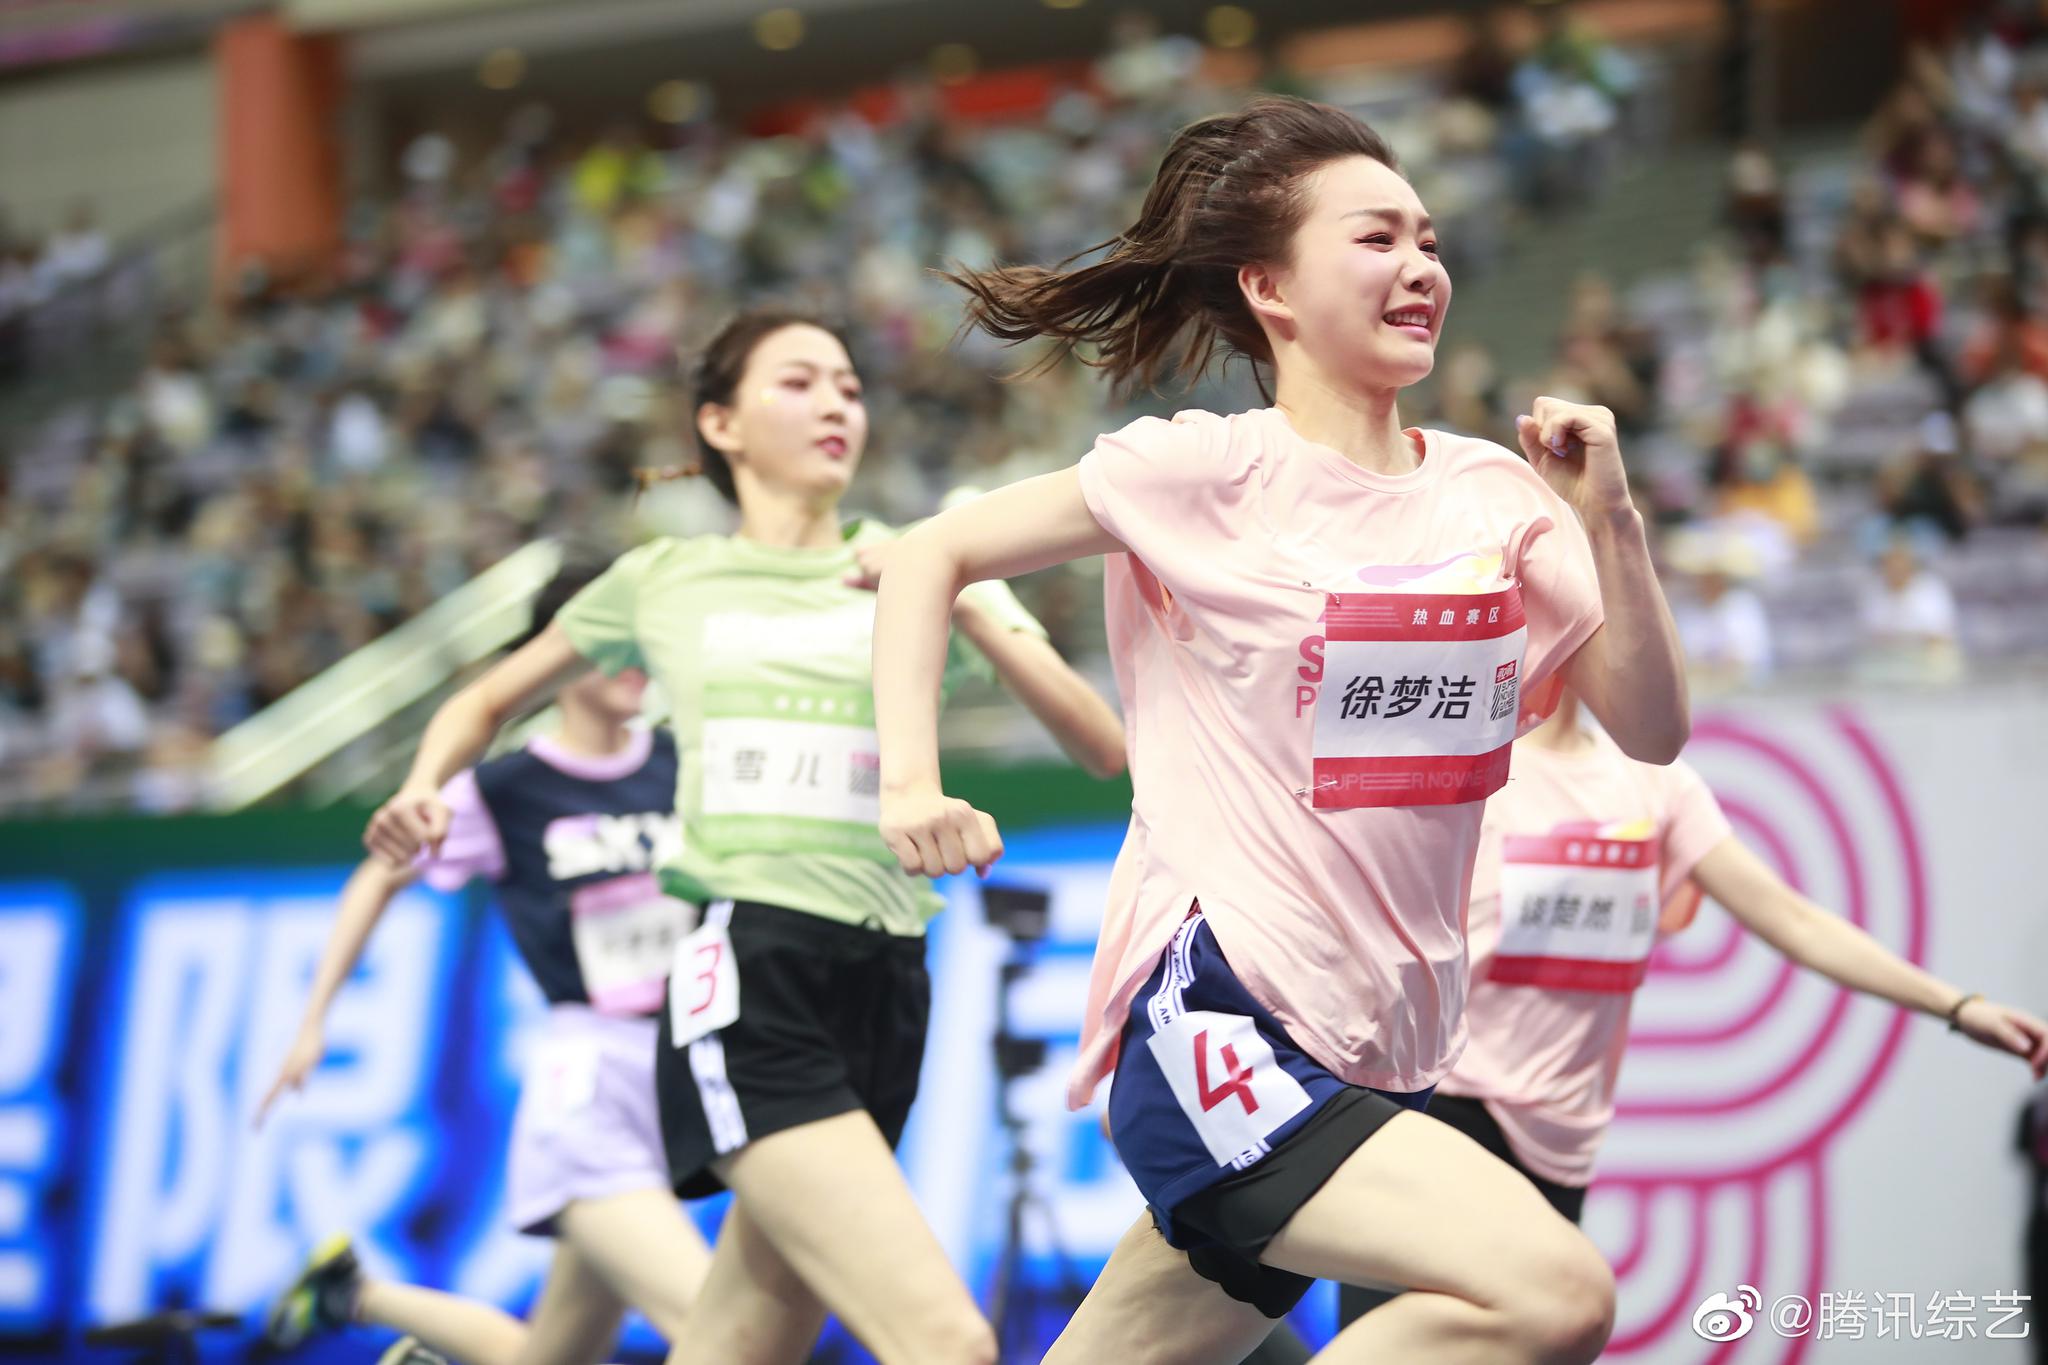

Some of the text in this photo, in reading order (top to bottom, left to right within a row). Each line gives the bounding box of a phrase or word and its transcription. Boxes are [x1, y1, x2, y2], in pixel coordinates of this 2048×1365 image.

[1412, 606, 1500, 625] 热血赛区
[1340, 674, 1477, 720] 徐梦洁
[733, 748, 820, 787] 雪儿
[690, 943, 722, 1016] 3
[1193, 1029, 1260, 1116] 4
